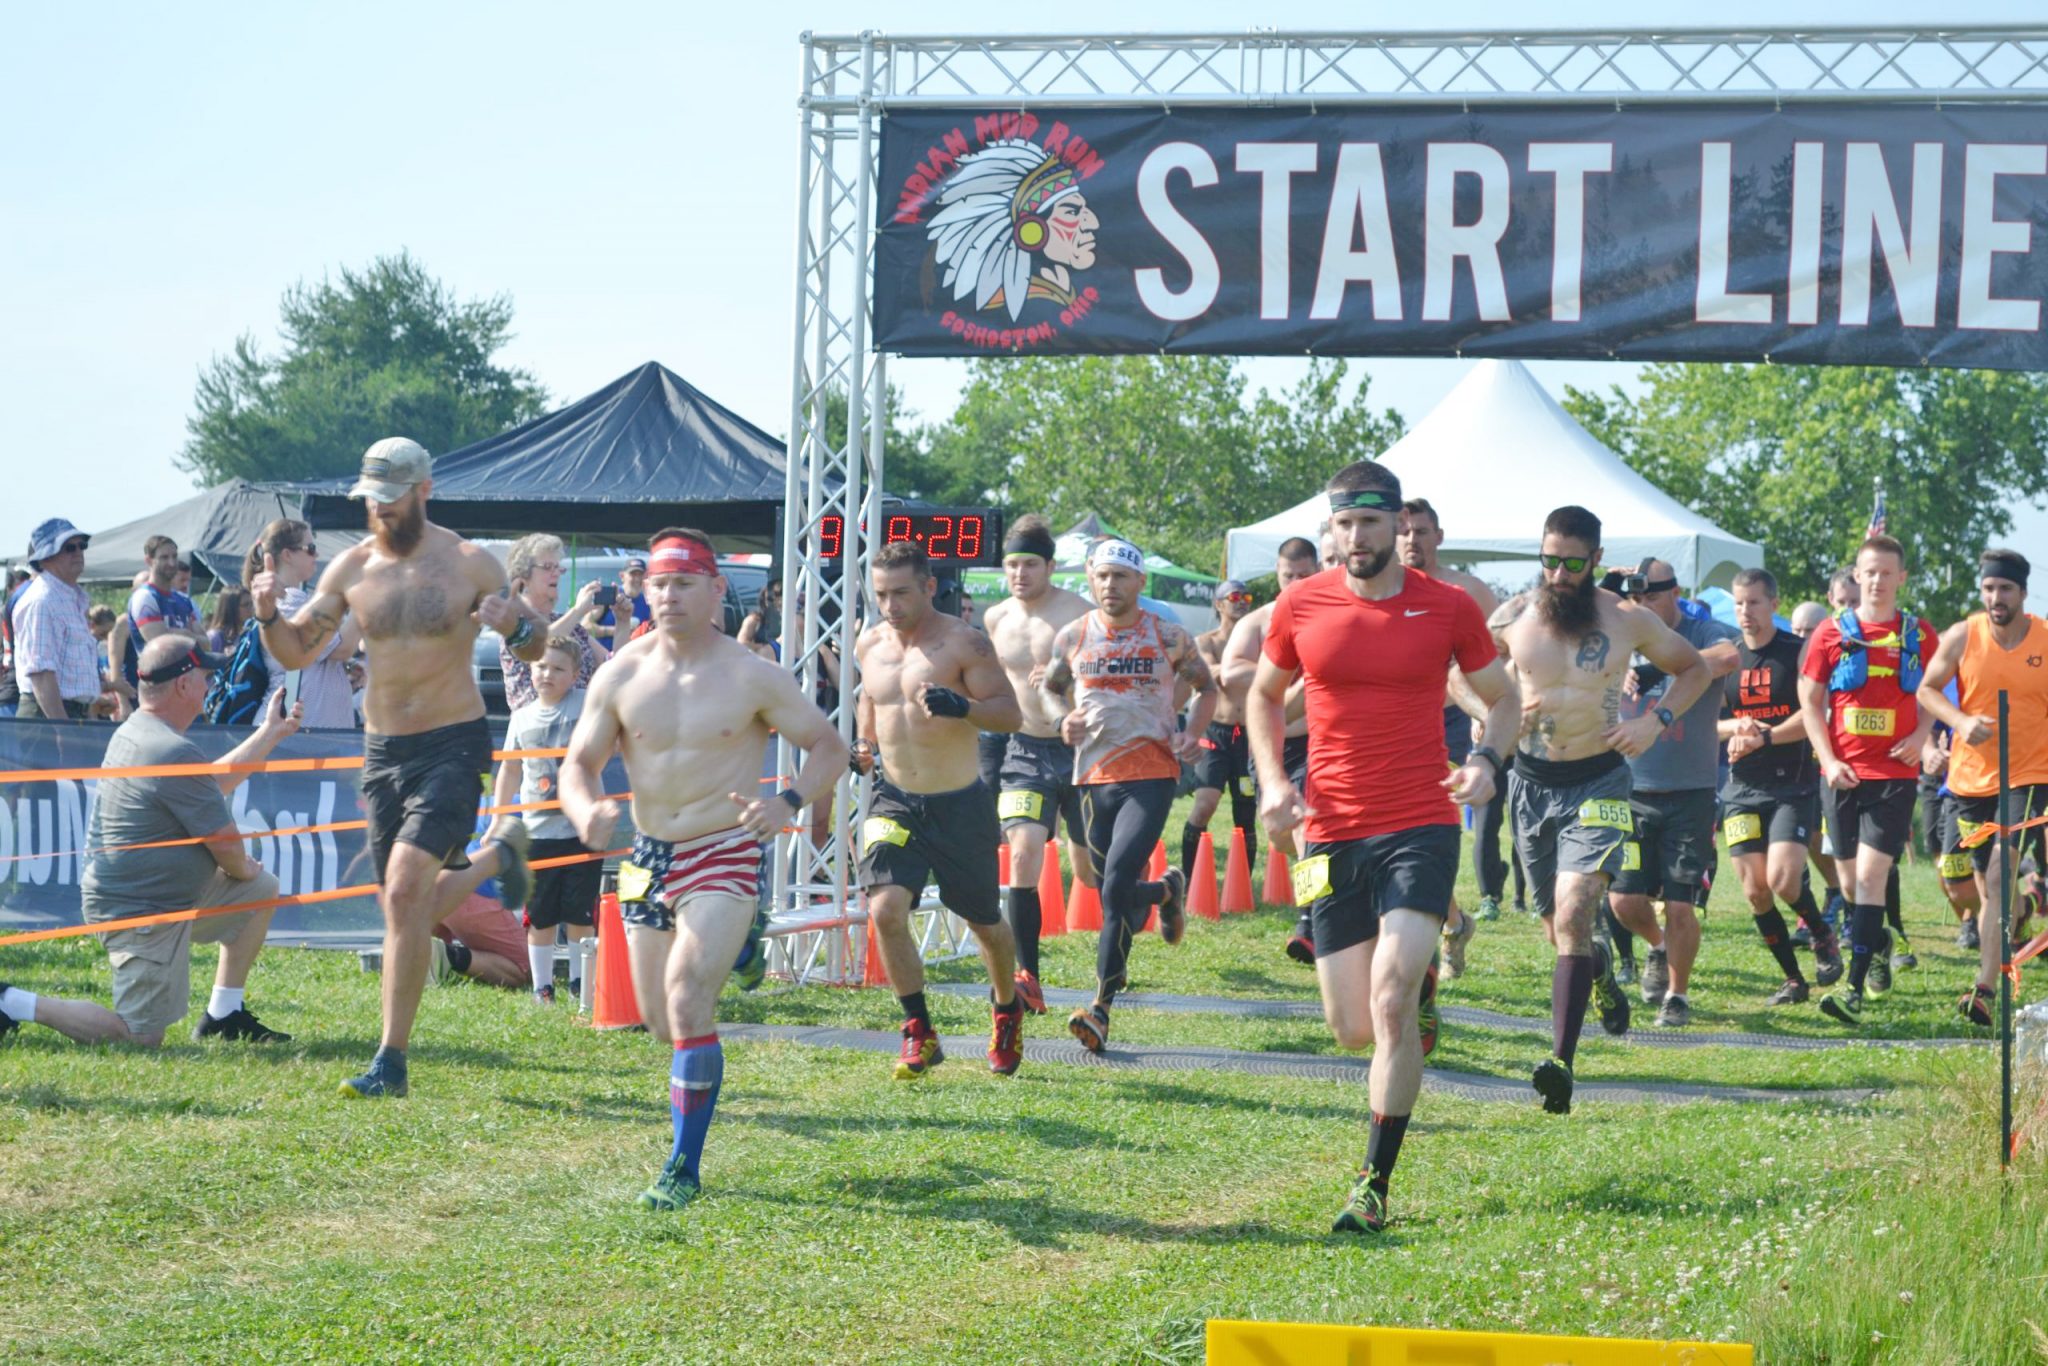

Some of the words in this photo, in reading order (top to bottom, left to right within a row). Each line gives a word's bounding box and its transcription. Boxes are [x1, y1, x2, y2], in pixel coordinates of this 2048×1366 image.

[893, 127, 971, 225] INDIAN
[974, 112, 1040, 146] MUD
[1043, 120, 1105, 181] RUN
[1134, 141, 1613, 322] START
[1695, 141, 2048, 331] LINE
[1060, 286, 1100, 328] OHIO
[1855, 714, 1886, 731] 1263
[1599, 804, 1630, 824] 655
